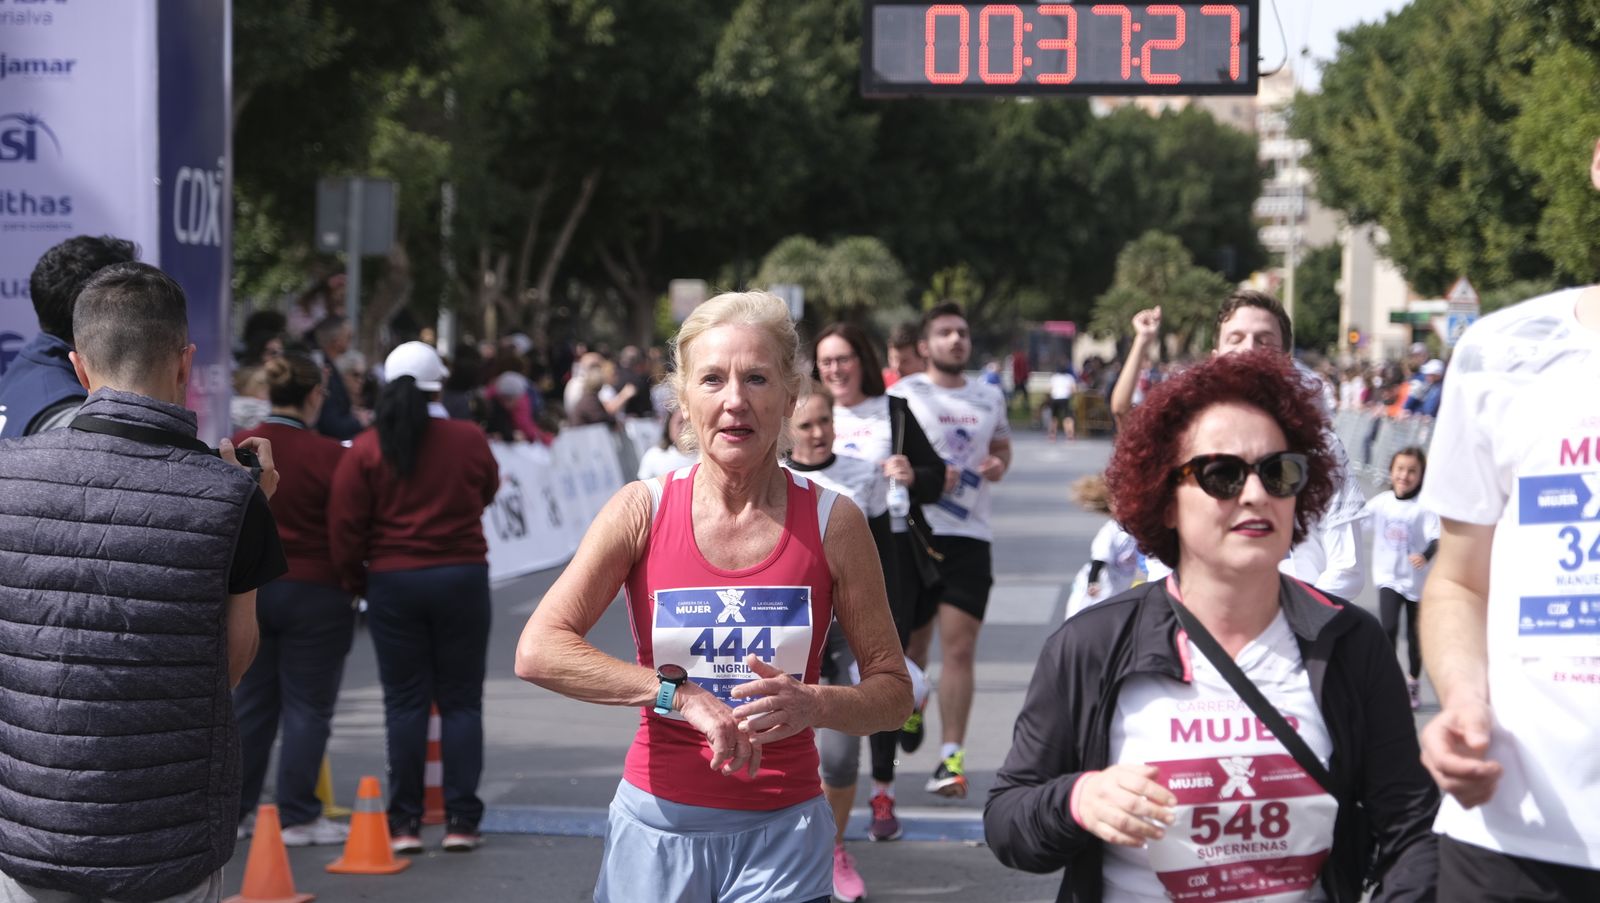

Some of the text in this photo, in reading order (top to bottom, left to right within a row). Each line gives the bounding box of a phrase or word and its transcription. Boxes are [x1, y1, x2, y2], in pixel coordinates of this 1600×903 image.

[924, 4, 1241, 84] 00:37:27
[675, 605, 712, 614] MUJER
[690, 627, 776, 663] 444
[1168, 776, 1214, 790] MUJER
[1190, 801, 1290, 845] 548
[1197, 840, 1288, 860] SUPERNENAS
